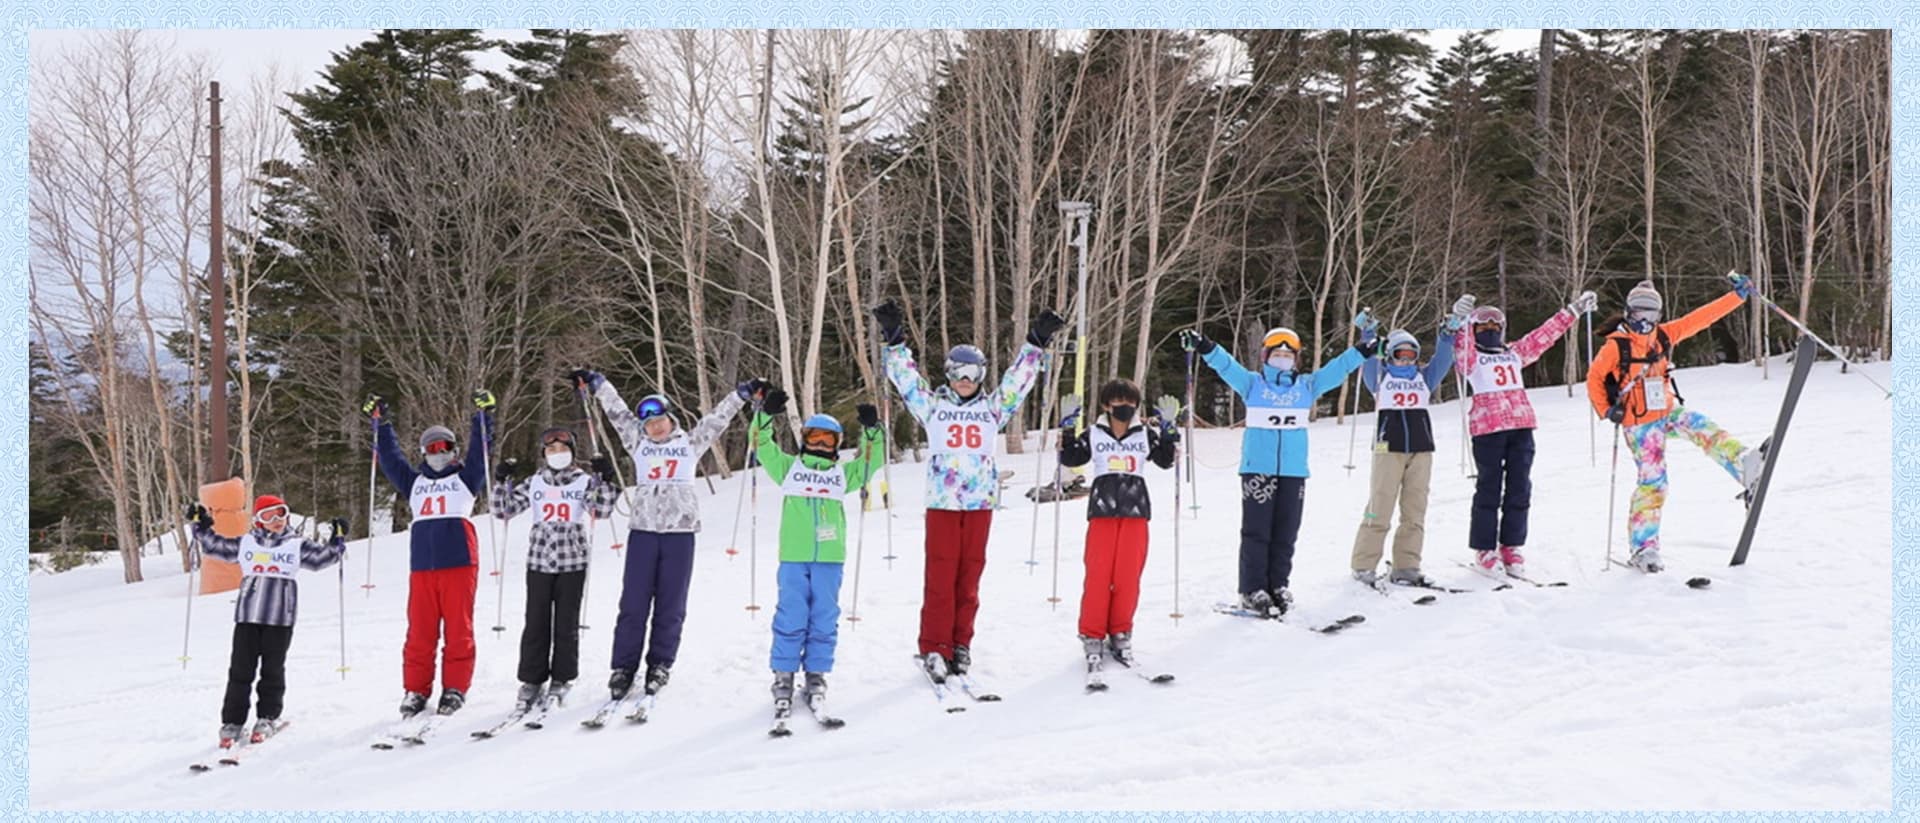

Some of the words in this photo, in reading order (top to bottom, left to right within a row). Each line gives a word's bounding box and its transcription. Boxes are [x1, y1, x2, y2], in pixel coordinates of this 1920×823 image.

[1494, 365, 1517, 386] 31
[937, 410, 990, 423] ONTAKE
[947, 424, 982, 448] 36
[642, 446, 688, 456] ONTAKE
[415, 481, 461, 495] ONTAKE
[793, 472, 841, 487] ONTAKE
[420, 495, 446, 515] 41
[543, 502, 570, 521] 29
